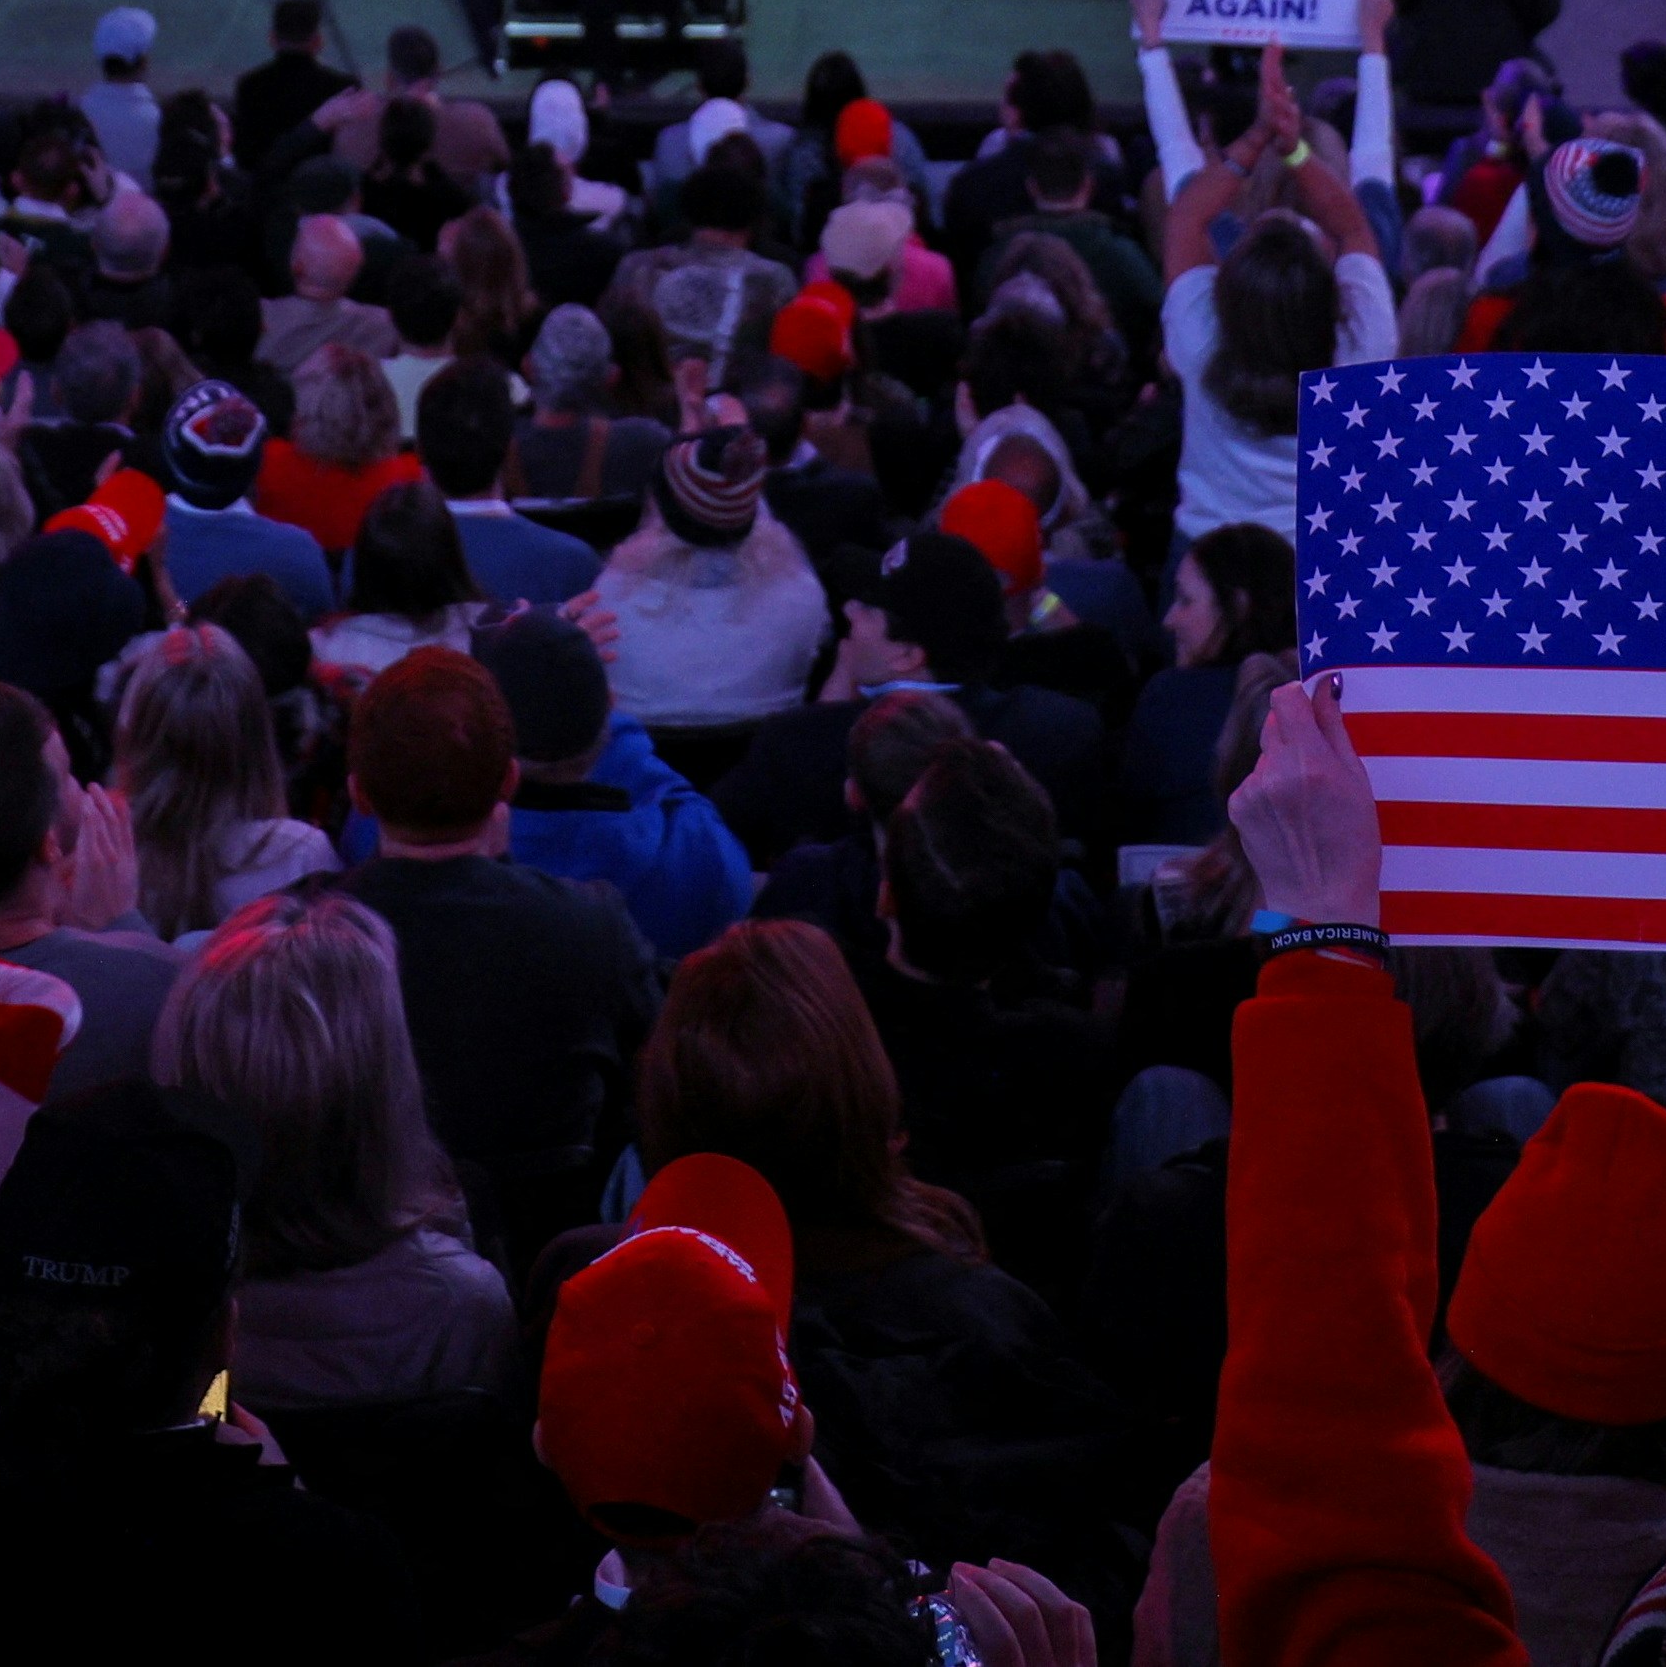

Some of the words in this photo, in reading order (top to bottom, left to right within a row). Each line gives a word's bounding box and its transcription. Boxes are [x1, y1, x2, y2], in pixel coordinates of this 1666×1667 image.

[1271, 930, 1312, 949] BACK!
[1315, 927, 1380, 944] AMERICA
[21, 1255, 133, 1286] TRUMP
